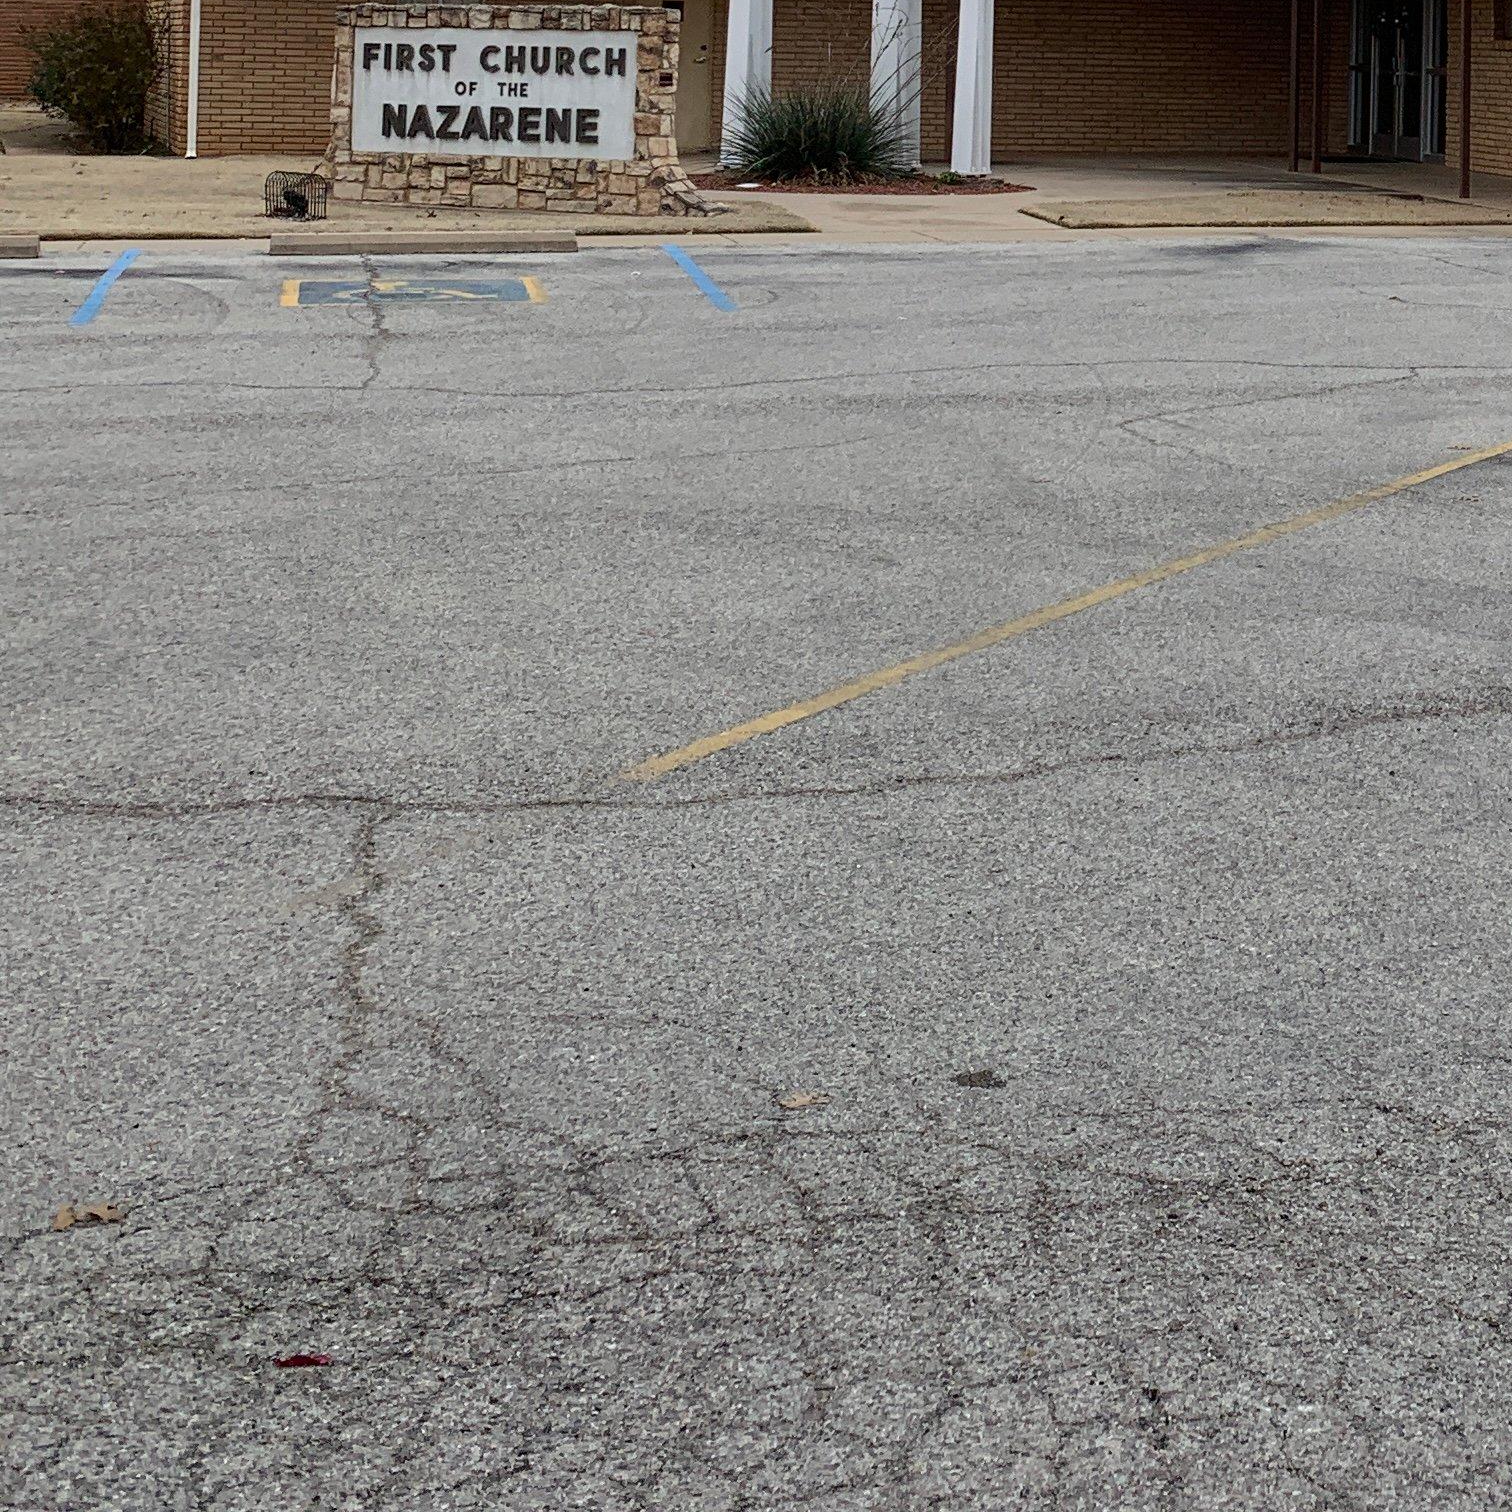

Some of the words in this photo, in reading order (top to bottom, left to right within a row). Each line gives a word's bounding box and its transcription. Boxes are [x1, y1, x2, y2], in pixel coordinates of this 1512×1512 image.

[362, 42, 457, 73] FIRST
[479, 44, 627, 77] CHURCH
[454, 81, 479, 97] OF
[497, 82, 529, 98] THE
[381, 103, 600, 145] NAZARENE
